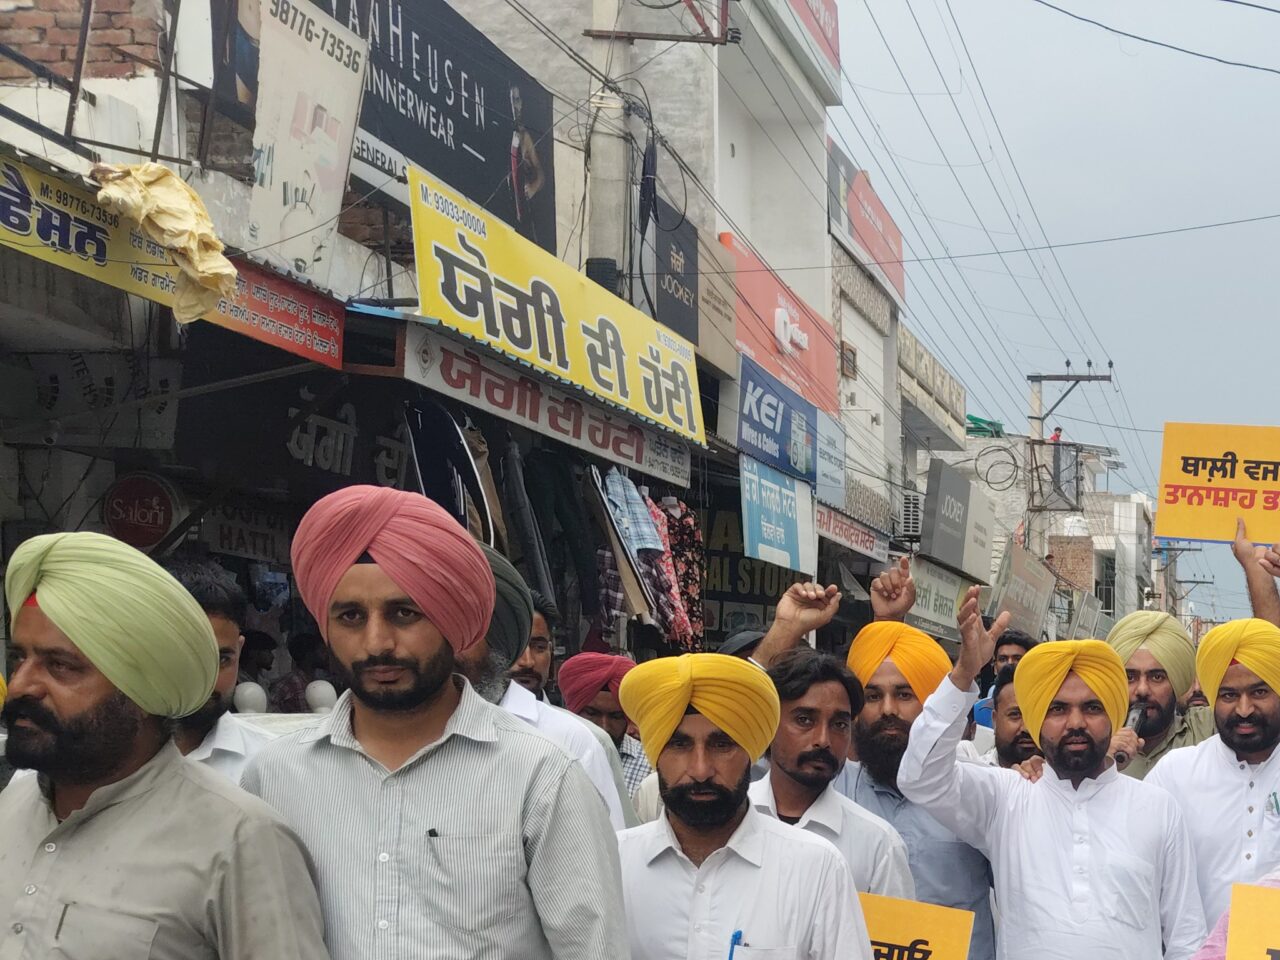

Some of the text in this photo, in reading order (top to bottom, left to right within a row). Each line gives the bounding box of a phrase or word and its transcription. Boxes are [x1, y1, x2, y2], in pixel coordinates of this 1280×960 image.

[389, 0, 485, 130] HEUSEN
[365, 61, 455, 150] INNERWEAR
[660, 274, 695, 308] JOCKEY
[432, 231, 697, 434] ਯੋਗੀ ਦੀ ਹੱਟੀ
[547, 394, 585, 441] ਦੀ
[742, 380, 785, 434] KEI
[112, 498, 166, 527] Saloni
[941, 494, 965, 524] JOCKEY
[1164, 484, 1256, 510] ਤਾਨਾਸ਼ਾਹ
